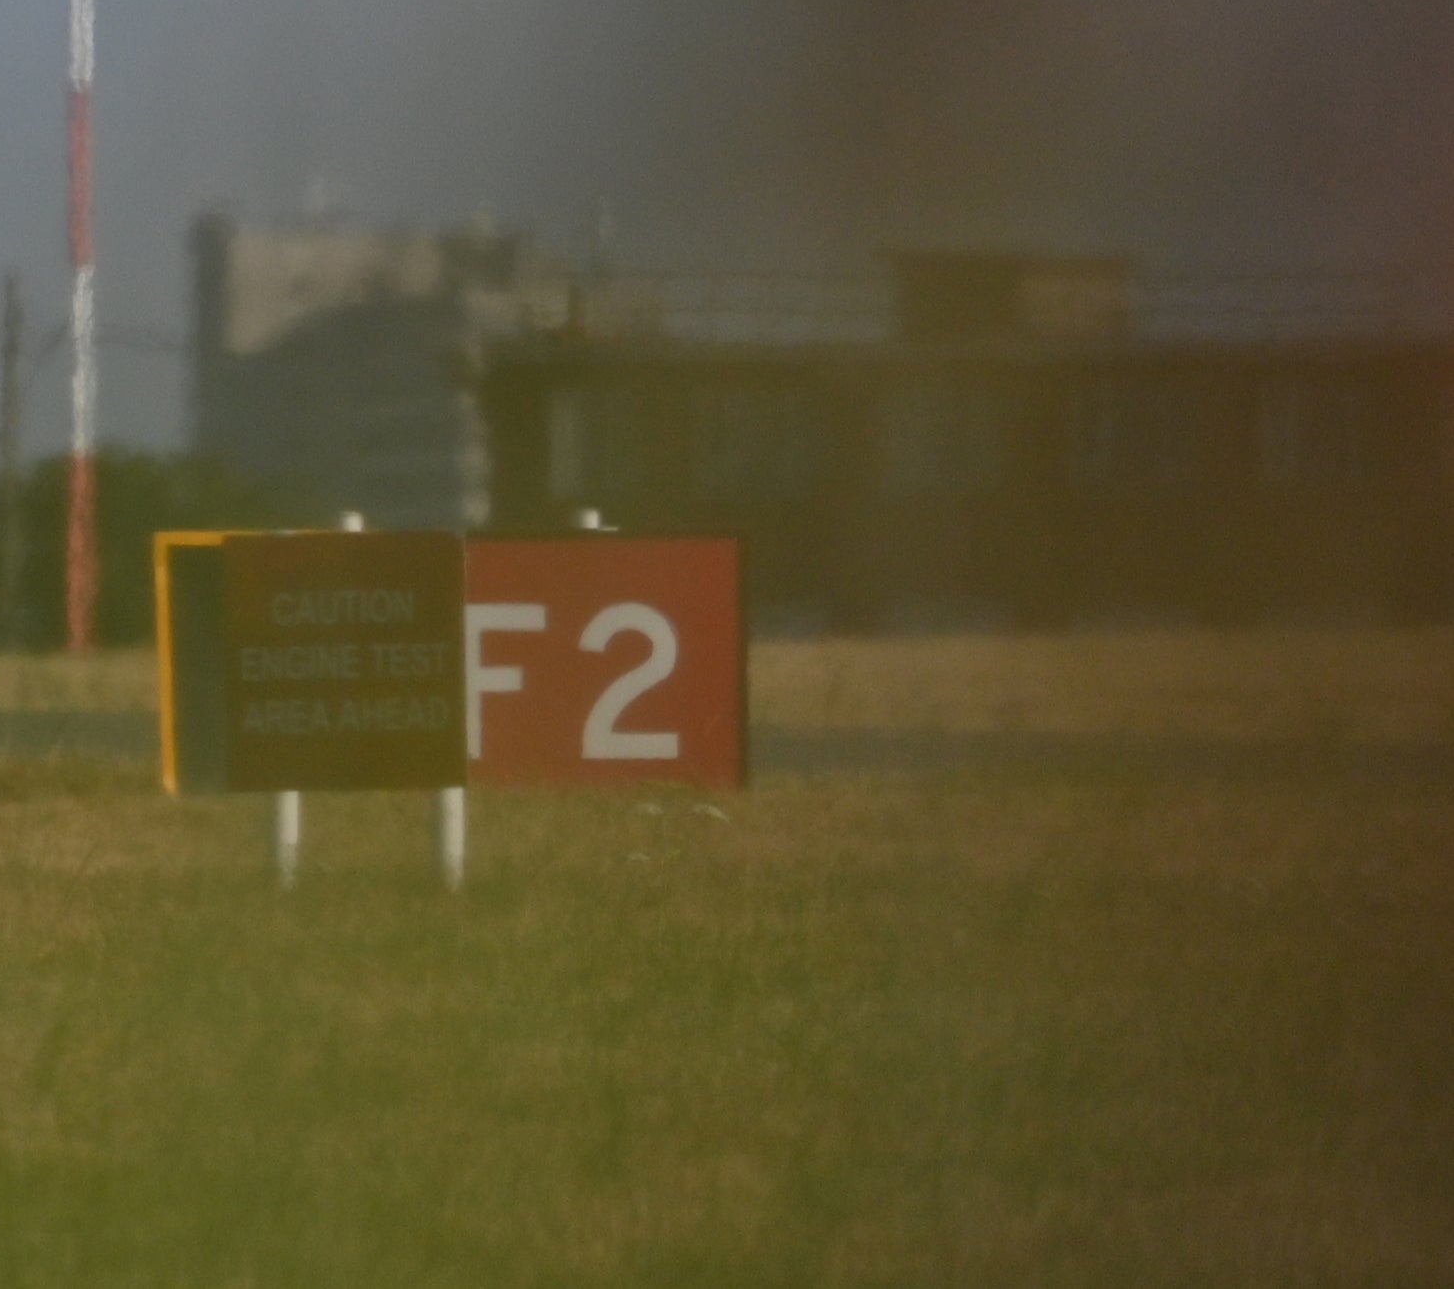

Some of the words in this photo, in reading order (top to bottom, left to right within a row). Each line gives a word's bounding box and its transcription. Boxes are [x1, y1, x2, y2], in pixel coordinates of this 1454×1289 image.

[271, 589, 414, 625] CAUTION
[241, 644, 360, 681] ENGINE
[369, 641, 448, 677] TEST
[243, 699, 330, 733] AREA
[337, 694, 449, 731] AHEAD
